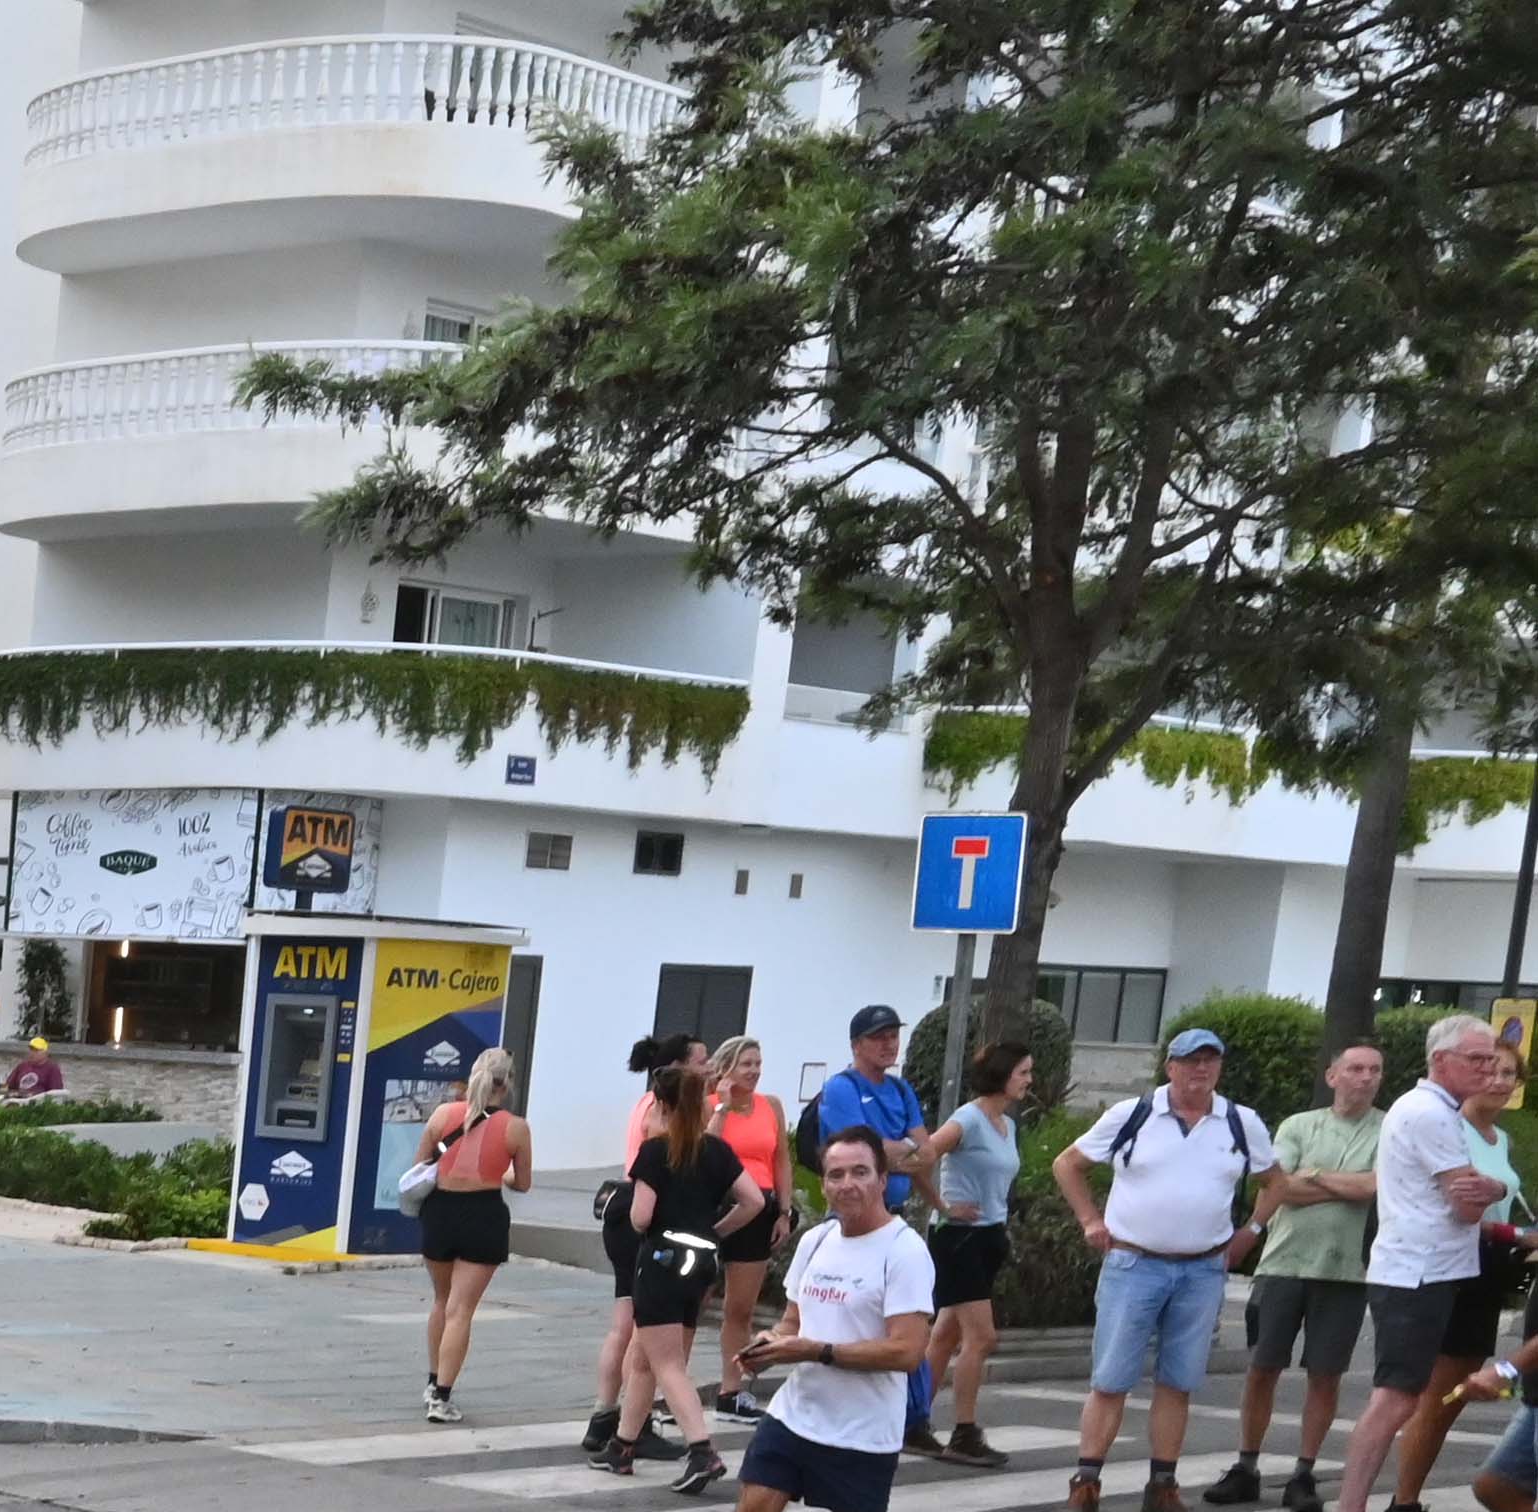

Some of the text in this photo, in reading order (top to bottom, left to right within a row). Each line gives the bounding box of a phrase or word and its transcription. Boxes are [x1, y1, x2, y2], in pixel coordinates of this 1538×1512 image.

[46, 813, 92, 837] Coffee
[178, 811, 211, 837] 100%
[287, 814, 349, 848] ATM
[273, 945, 348, 980] ATM
[386, 967, 499, 995] ATM Cajero
